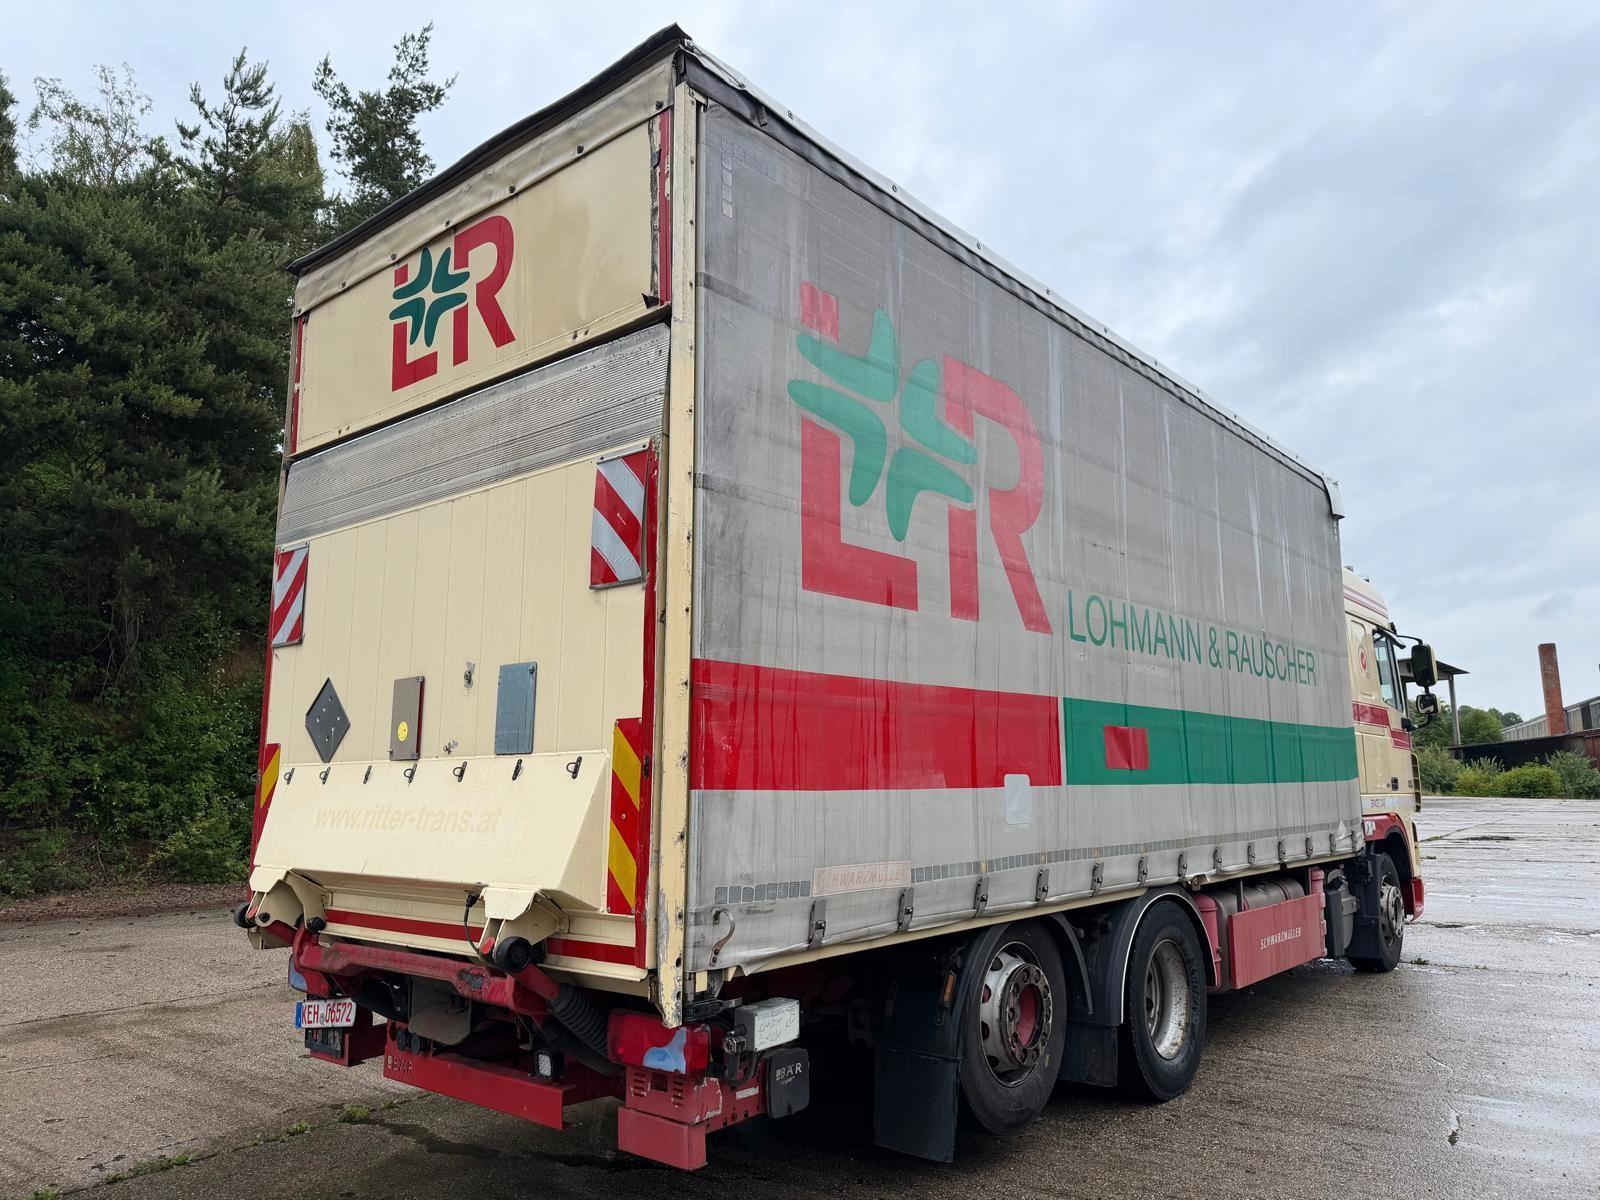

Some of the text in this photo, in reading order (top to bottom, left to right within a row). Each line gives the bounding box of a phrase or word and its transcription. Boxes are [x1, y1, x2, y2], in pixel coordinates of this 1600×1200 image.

[1067, 589, 1317, 686] LOHMANN & RAUSCHER
[314, 804, 504, 833] www.ritter-trans.at
[301, 1002, 353, 1024] KEH 06572
